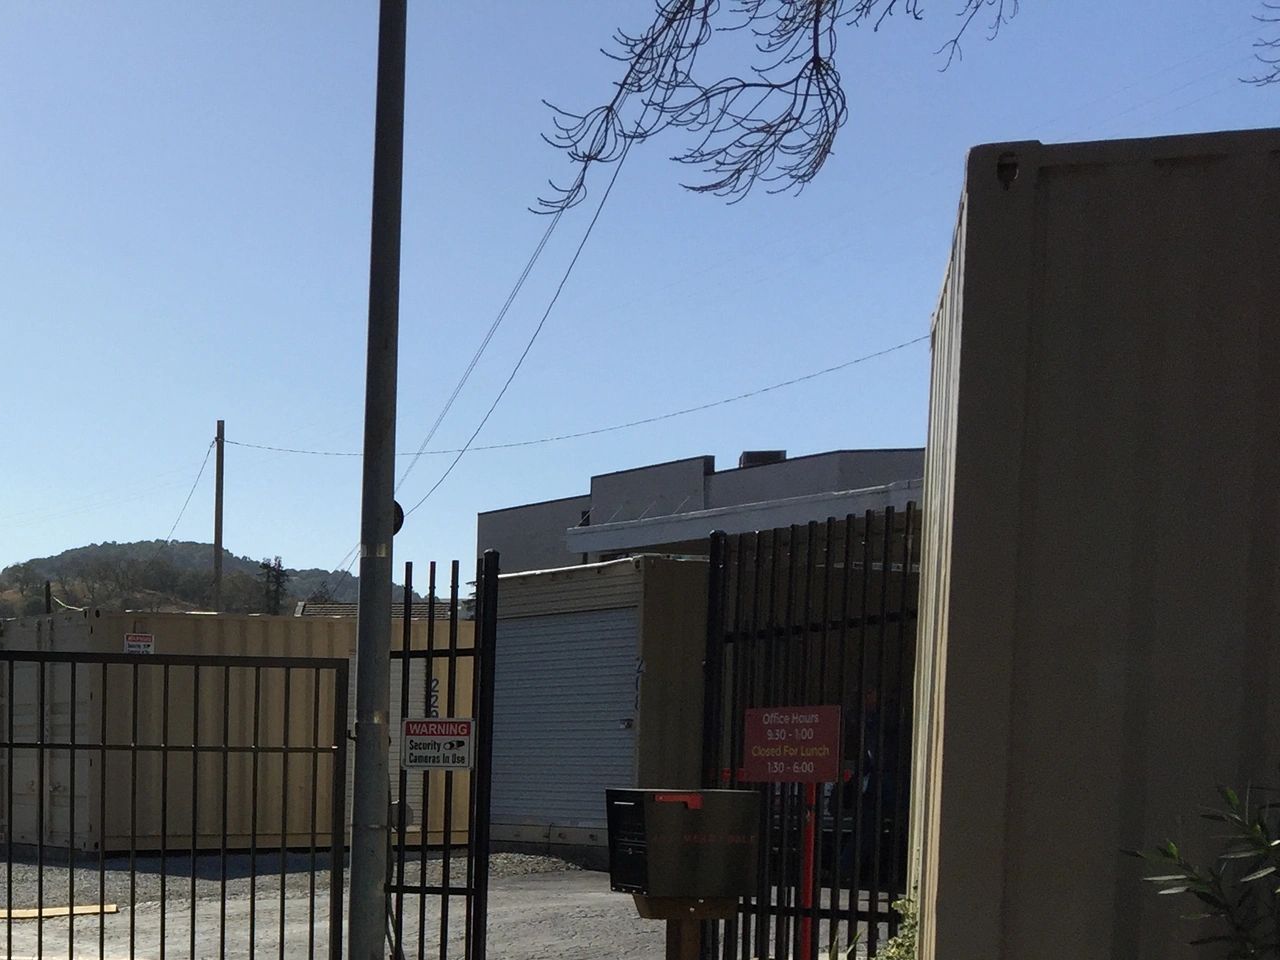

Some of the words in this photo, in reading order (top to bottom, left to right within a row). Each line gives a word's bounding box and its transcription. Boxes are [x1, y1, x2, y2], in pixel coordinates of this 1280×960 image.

[762, 713, 790, 724] Office
[791, 713, 819, 724] Hours
[409, 723, 468, 735] WARNING
[408, 739, 441, 753] Security
[751, 745, 781, 757] Closed
[783, 745, 798, 757] For
[800, 744, 830, 757] Lunch
[408, 753, 440, 764] Cameras
[442, 753, 450, 764] In
[452, 753, 466, 764] Use
